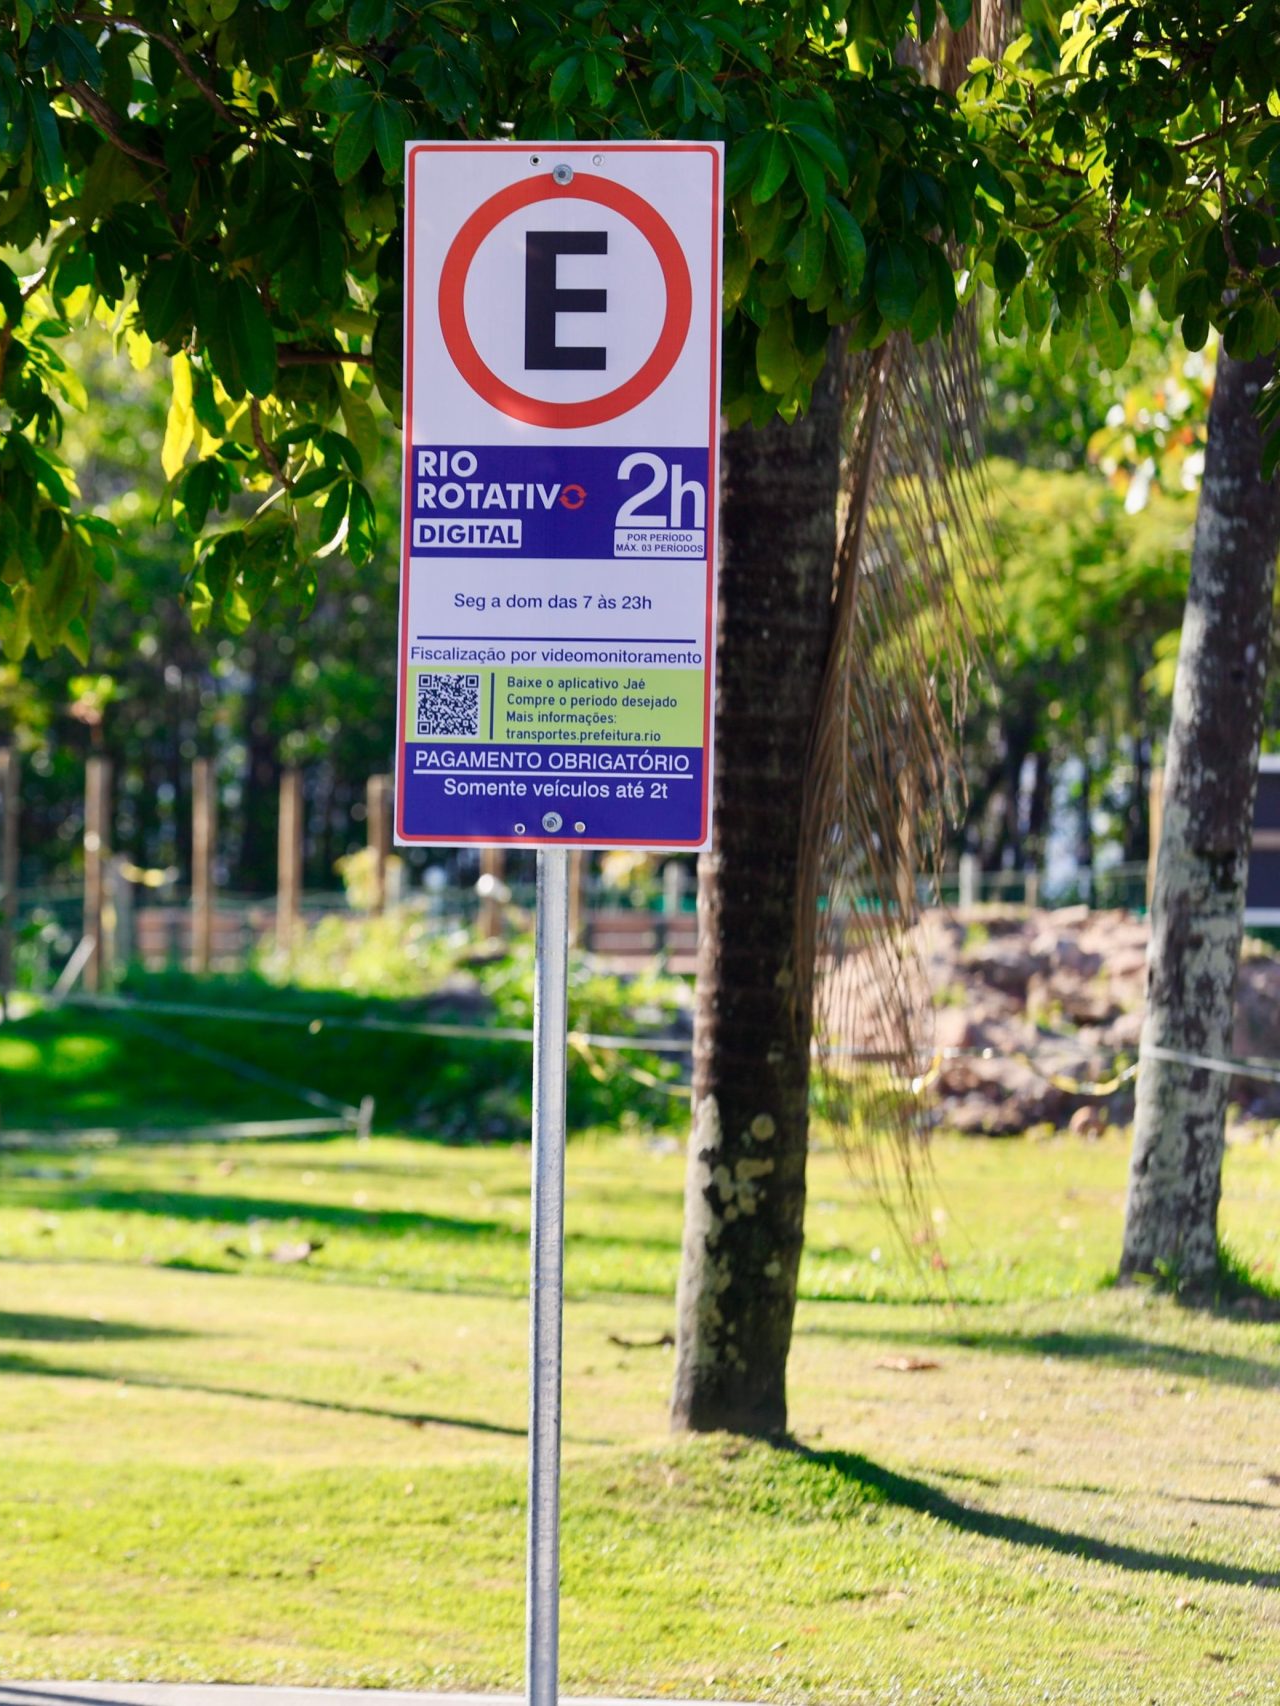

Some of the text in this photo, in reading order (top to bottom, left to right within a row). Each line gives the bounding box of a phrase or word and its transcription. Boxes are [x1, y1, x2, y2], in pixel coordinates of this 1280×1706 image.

[524, 231, 608, 371] E
[418, 450, 478, 477] RIO
[615, 452, 705, 528] 2h
[419, 524, 519, 544] DIGITAL
[627, 533, 692, 542] POR PERÍODO
[616, 543, 639, 551] MÁX.
[655, 544, 703, 552] PERÍODOS
[454, 593, 652, 611] Seg a dom das 7 às 23h
[410, 646, 702, 664] Fiscalização por videomonitoramento
[507, 676, 646, 691] Baixe o aplicativo Jaé
[507, 694, 555, 708] Compre
[559, 696, 566, 706] o
[622, 696, 677, 710] desejado
[506, 711, 617, 725] Mais informações:
[506, 728, 661, 742] transportes.prefeitura.rio
[415, 749, 690, 771] PAGAMENTO OBRIGATÓRIO
[444, 778, 668, 799] Somente veículos até 2t
